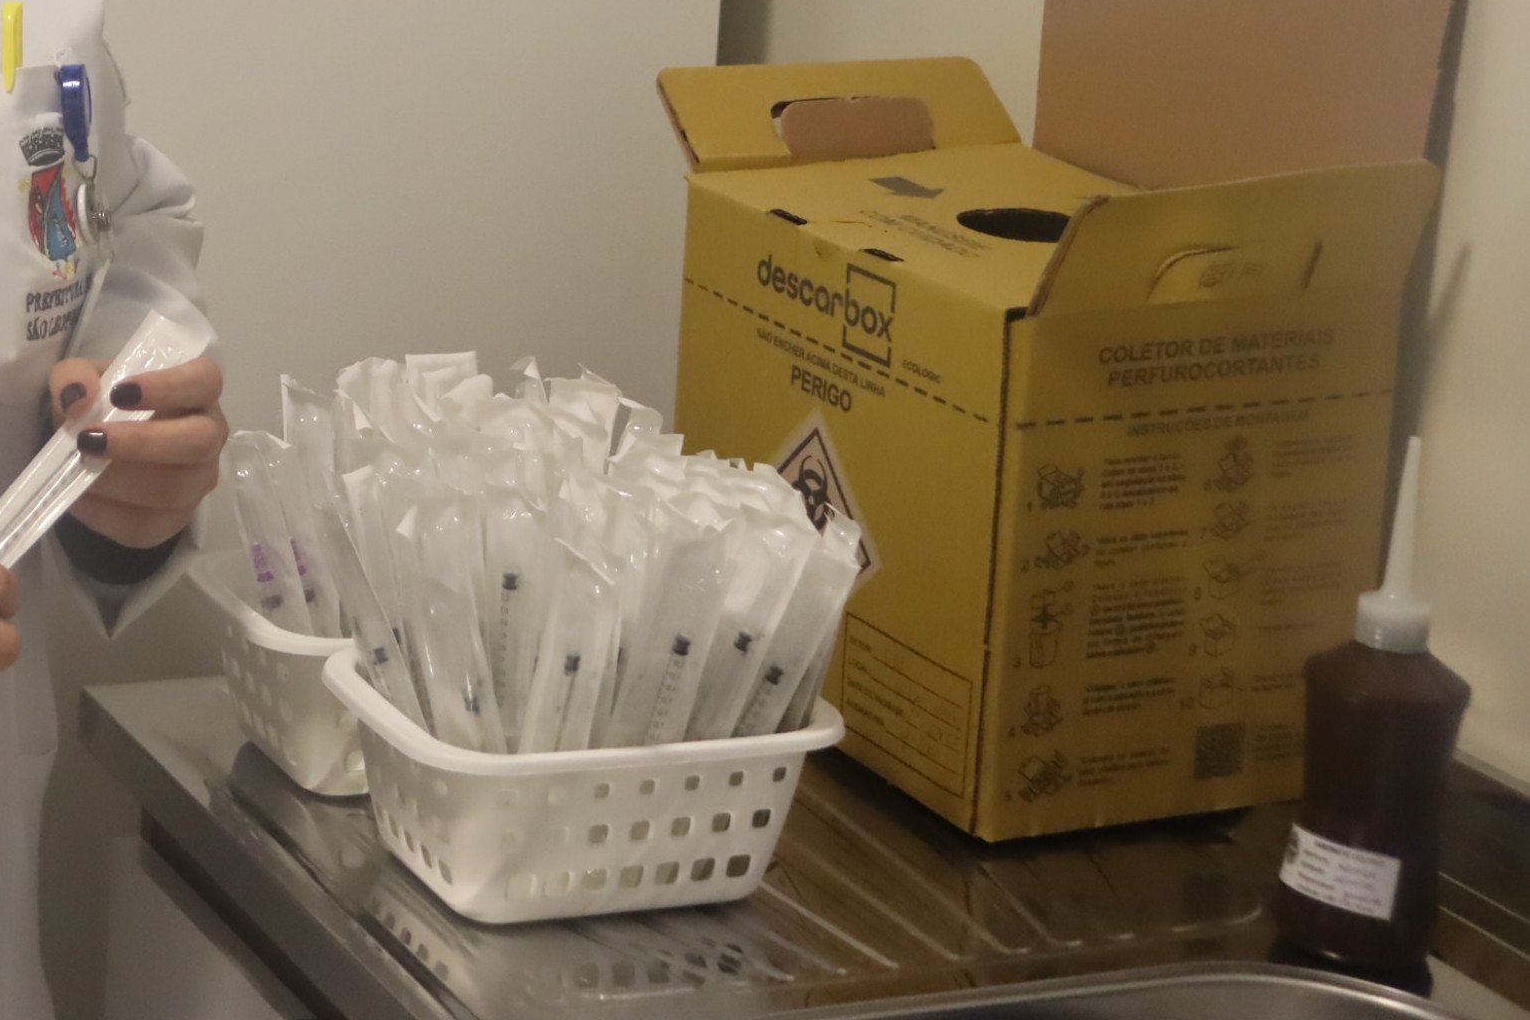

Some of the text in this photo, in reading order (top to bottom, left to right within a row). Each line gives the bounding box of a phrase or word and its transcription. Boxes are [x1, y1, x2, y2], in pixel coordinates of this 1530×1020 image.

[757, 254, 895, 343] descarbox
[1098, 328, 1335, 365] COLETOR DE MATERIAIS
[791, 365, 852, 412] PERIGO
[1107, 353, 1321, 388] PERFUROCORTANTES
